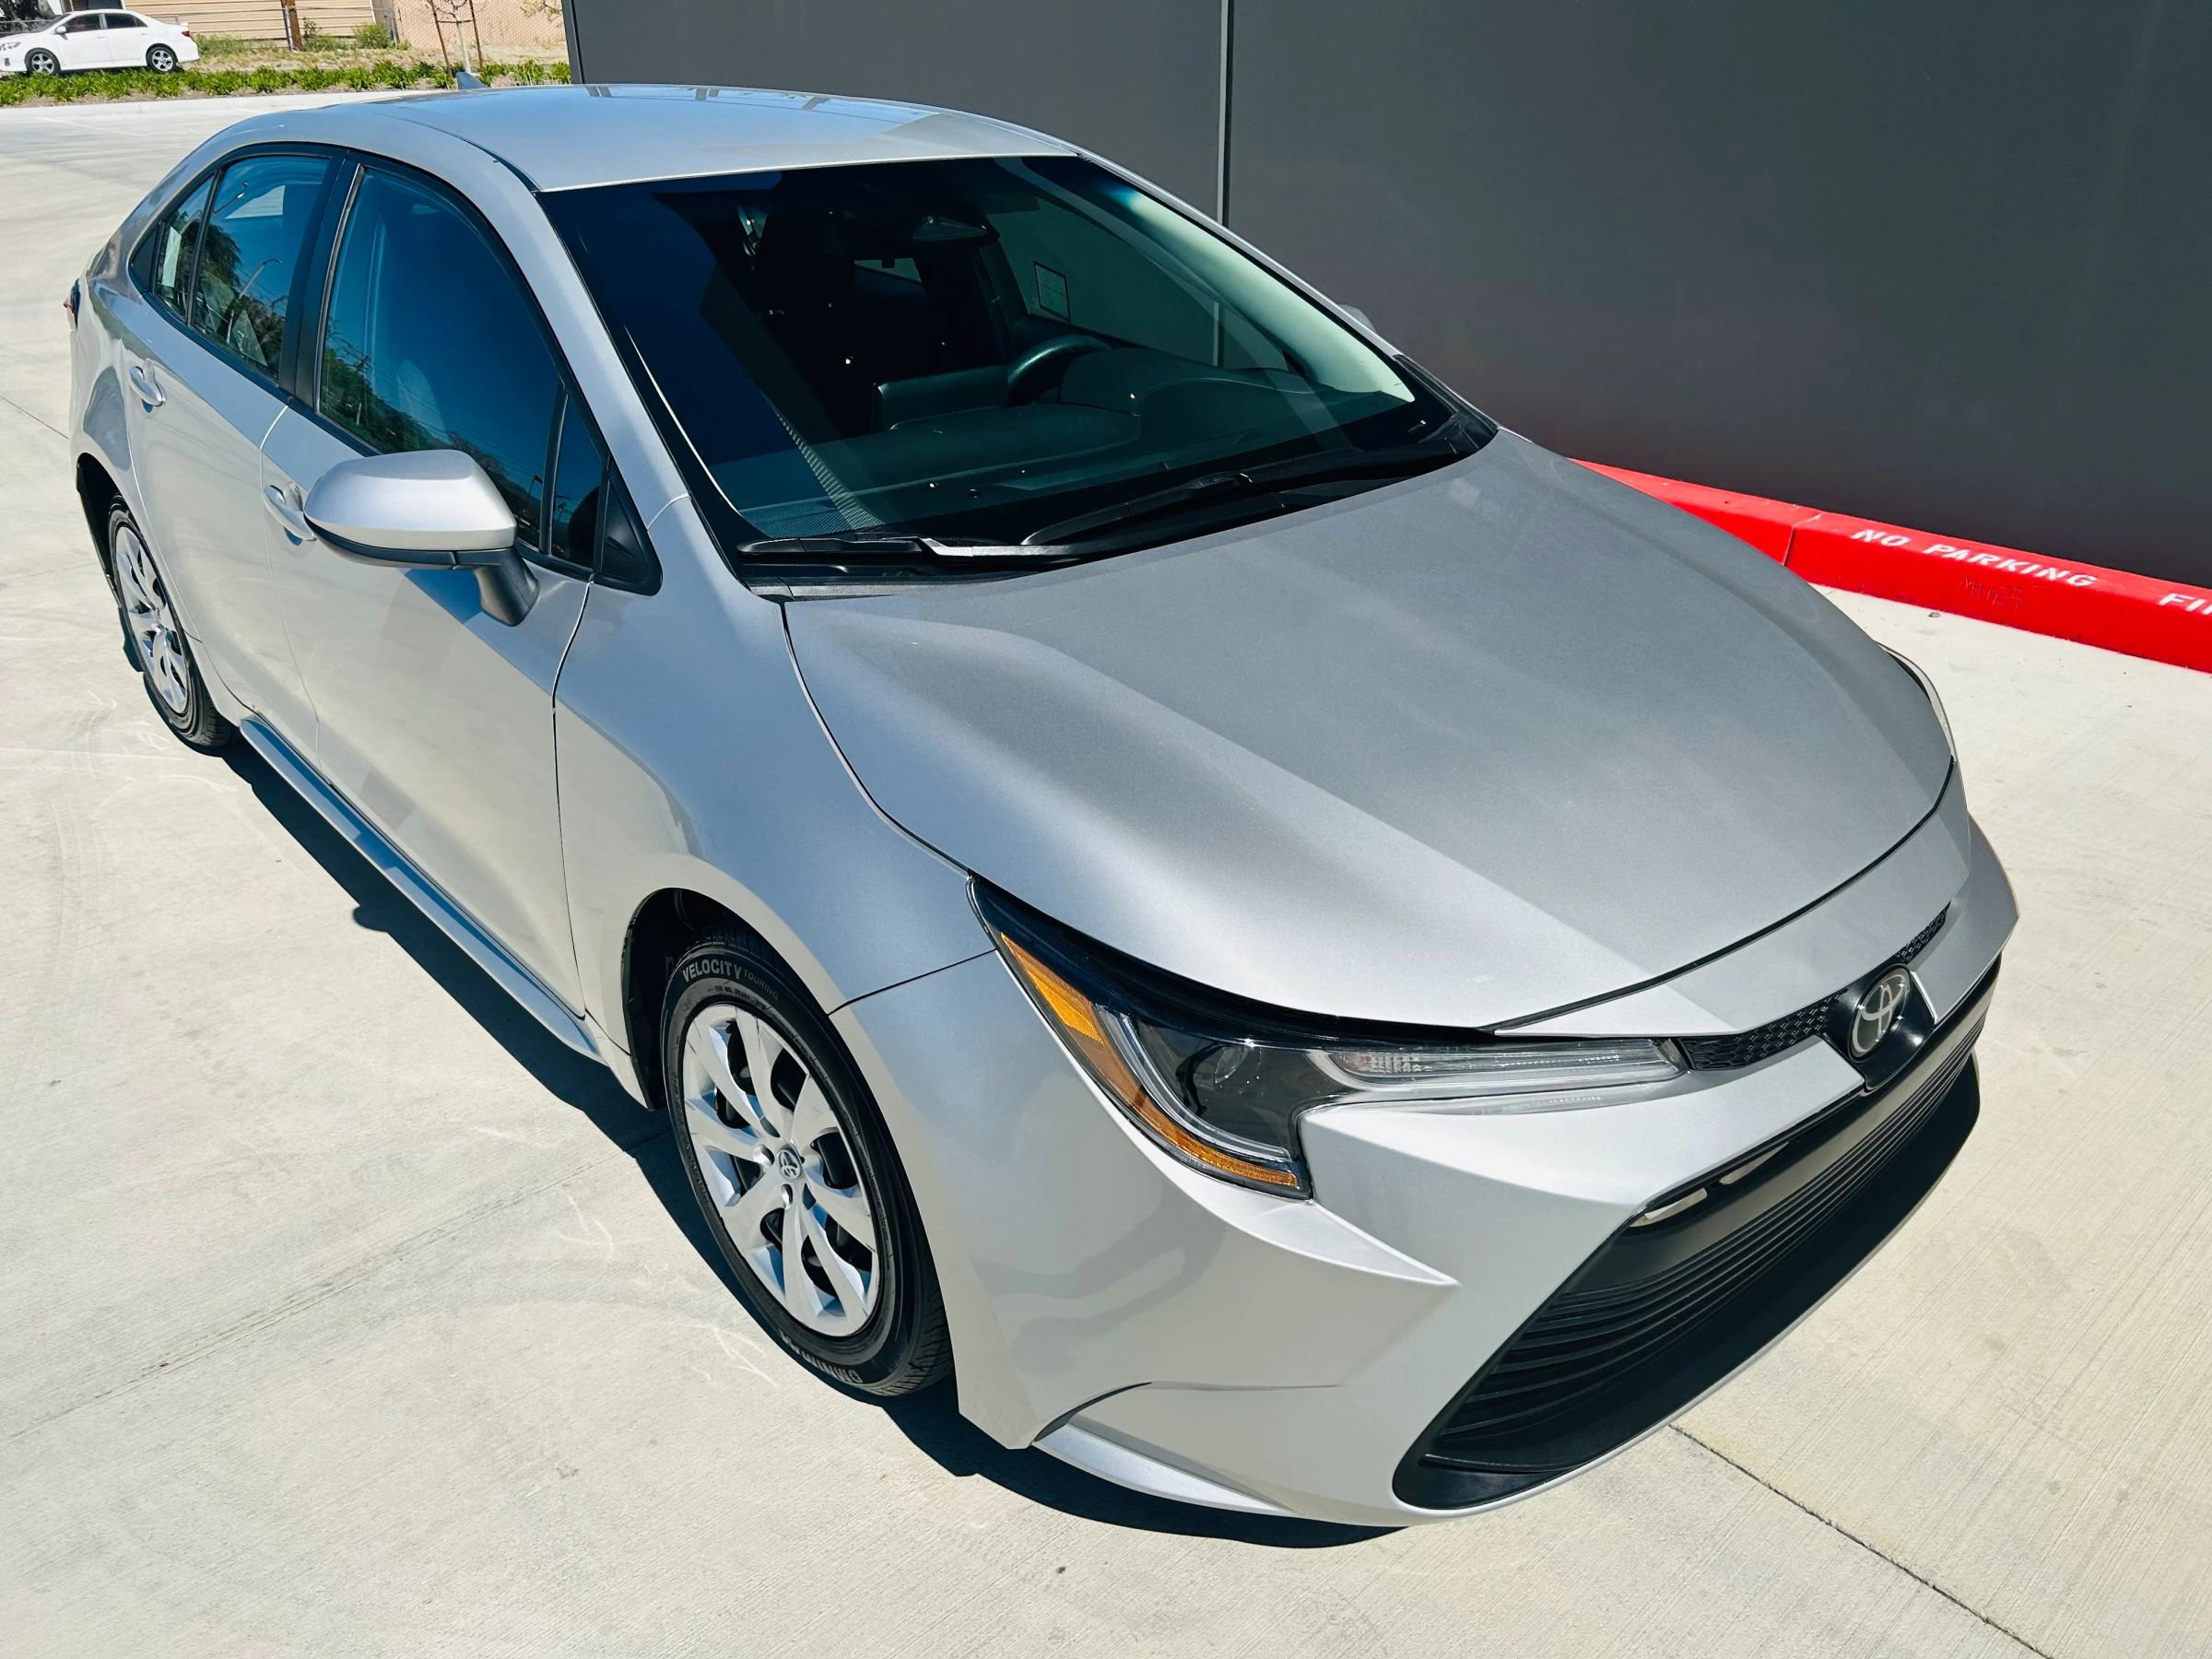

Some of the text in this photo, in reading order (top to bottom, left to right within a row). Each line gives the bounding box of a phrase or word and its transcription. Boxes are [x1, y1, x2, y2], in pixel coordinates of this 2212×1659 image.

[1851, 529, 1911, 547] NO
[1922, 544, 2098, 586] PARKING
[682, 959, 743, 982] VELOCITY
[743, 970, 780, 1000] TOURING
